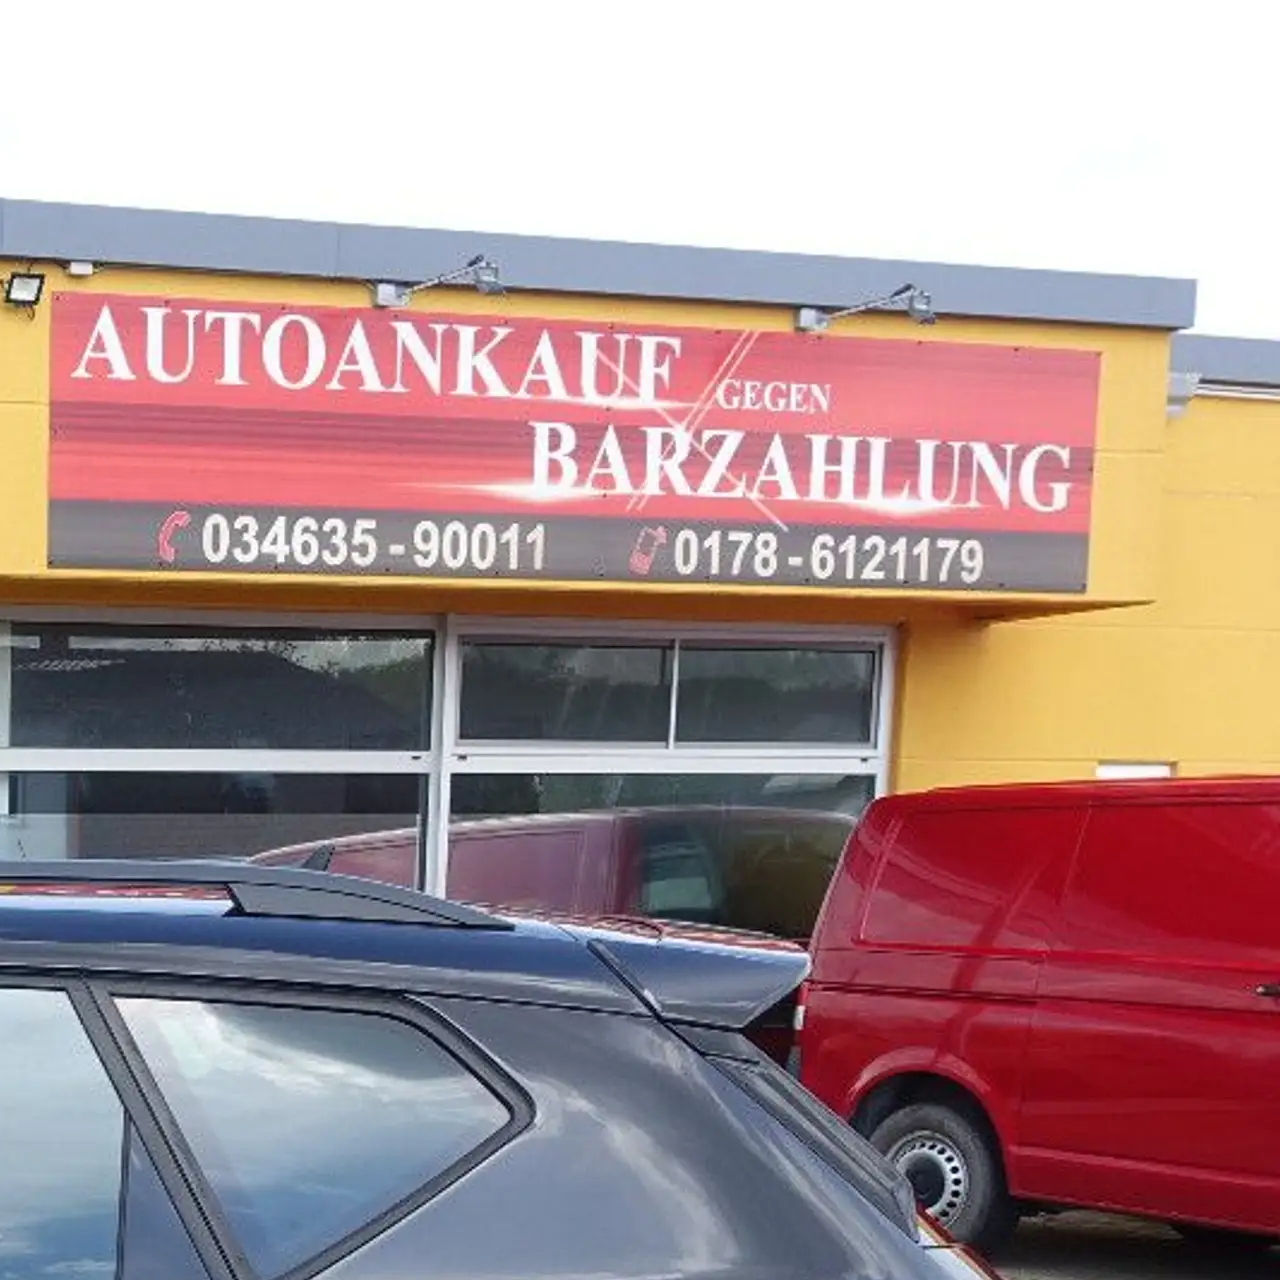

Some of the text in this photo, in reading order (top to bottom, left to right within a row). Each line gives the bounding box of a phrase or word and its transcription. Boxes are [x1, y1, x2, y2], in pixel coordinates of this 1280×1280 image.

[70, 303, 832, 414] AUTOANKAUF GEGEN
[528, 420, 1074, 514] BARZAHLUNG
